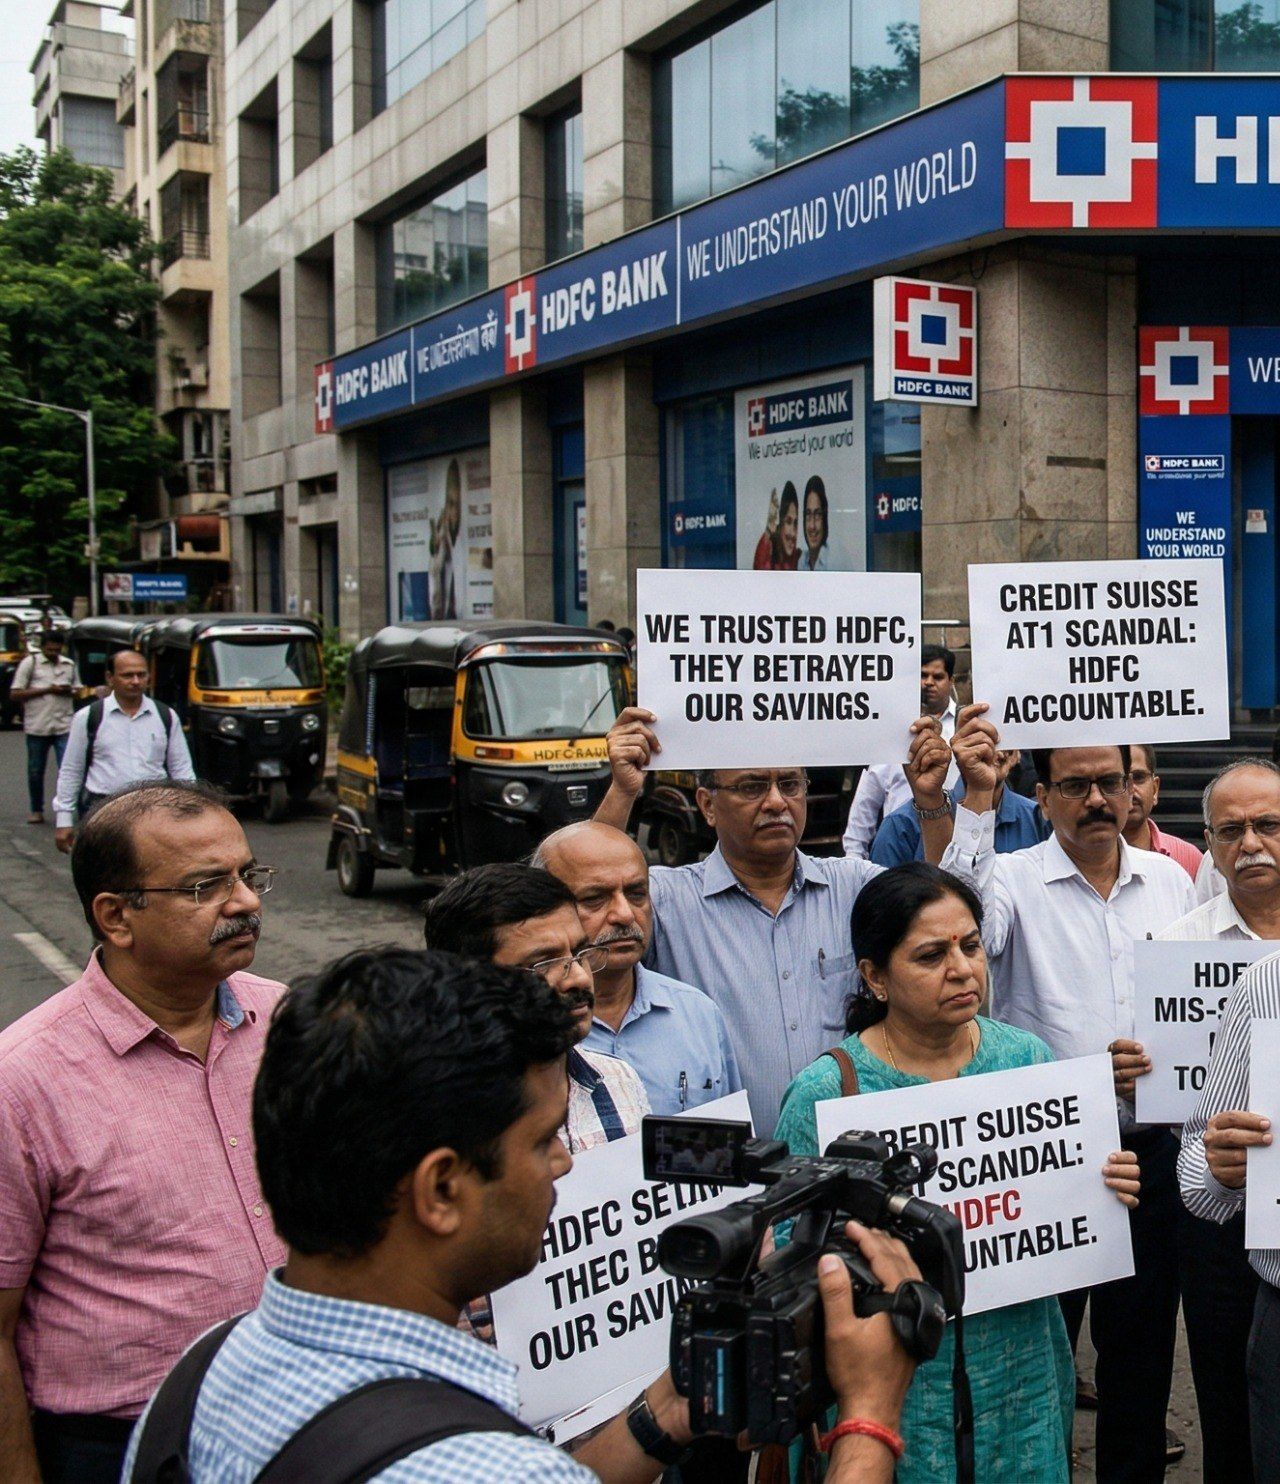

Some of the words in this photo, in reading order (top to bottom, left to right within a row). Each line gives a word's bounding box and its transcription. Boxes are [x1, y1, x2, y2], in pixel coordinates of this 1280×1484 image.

[687, 239, 711, 282] WE
[715, 196, 828, 273] UNDERSTAND
[833, 174, 888, 232] YOUR
[894, 141, 978, 212] WORLD
[542, 277, 596, 335] HDFC
[602, 250, 668, 315] BANK
[336, 366, 369, 405] HDFC
[371, 350, 408, 393] BANK
[897, 380, 932, 394] HDFC
[935, 383, 970, 397] BANK
[769, 398, 805, 425] HDFC
[808, 390, 848, 417] BANK
[1191, 459, 1218, 468] BANK
[892, 496, 918, 512] HDFC
[1176, 511, 1195, 525] WE
[1146, 527, 1226, 541] UNDERSTAND
[1147, 544, 1179, 557] YOUR
[1182, 544, 1226, 557] WORLD
[999, 582, 1098, 612] CREDIT
[1106, 580, 1199, 609] SUISSE
[644, 614, 690, 643] WE
[700, 614, 826, 645] TRUSTED
[836, 615, 915, 648] HDFC,
[1006, 620, 1053, 649] AT1
[1065, 617, 1197, 648] SCANDAL:
[669, 654, 744, 682] THEY
[753, 654, 894, 682] BETRAYED
[1068, 654, 1140, 684] HDFC
[685, 693, 744, 722] OUR
[752, 692, 880, 722] SAVINGS.
[1003, 688, 1205, 724] ACCOUNTABLE.
[1194, 962, 1254, 988] HDF
[1173, 1065, 1206, 1091] TO
[879, 1115, 967, 1158] REDIT
[976, 1095, 1081, 1142] SUISSE
[937, 1138, 1084, 1193] SCANDAL:
[540, 1199, 623, 1264] HDFC
[962, 1215, 1098, 1274] UNTABLE.
[544, 1248, 630, 1311] THEC
[637, 1232, 661, 1276] B
[529, 1312, 599, 1371] OUR
